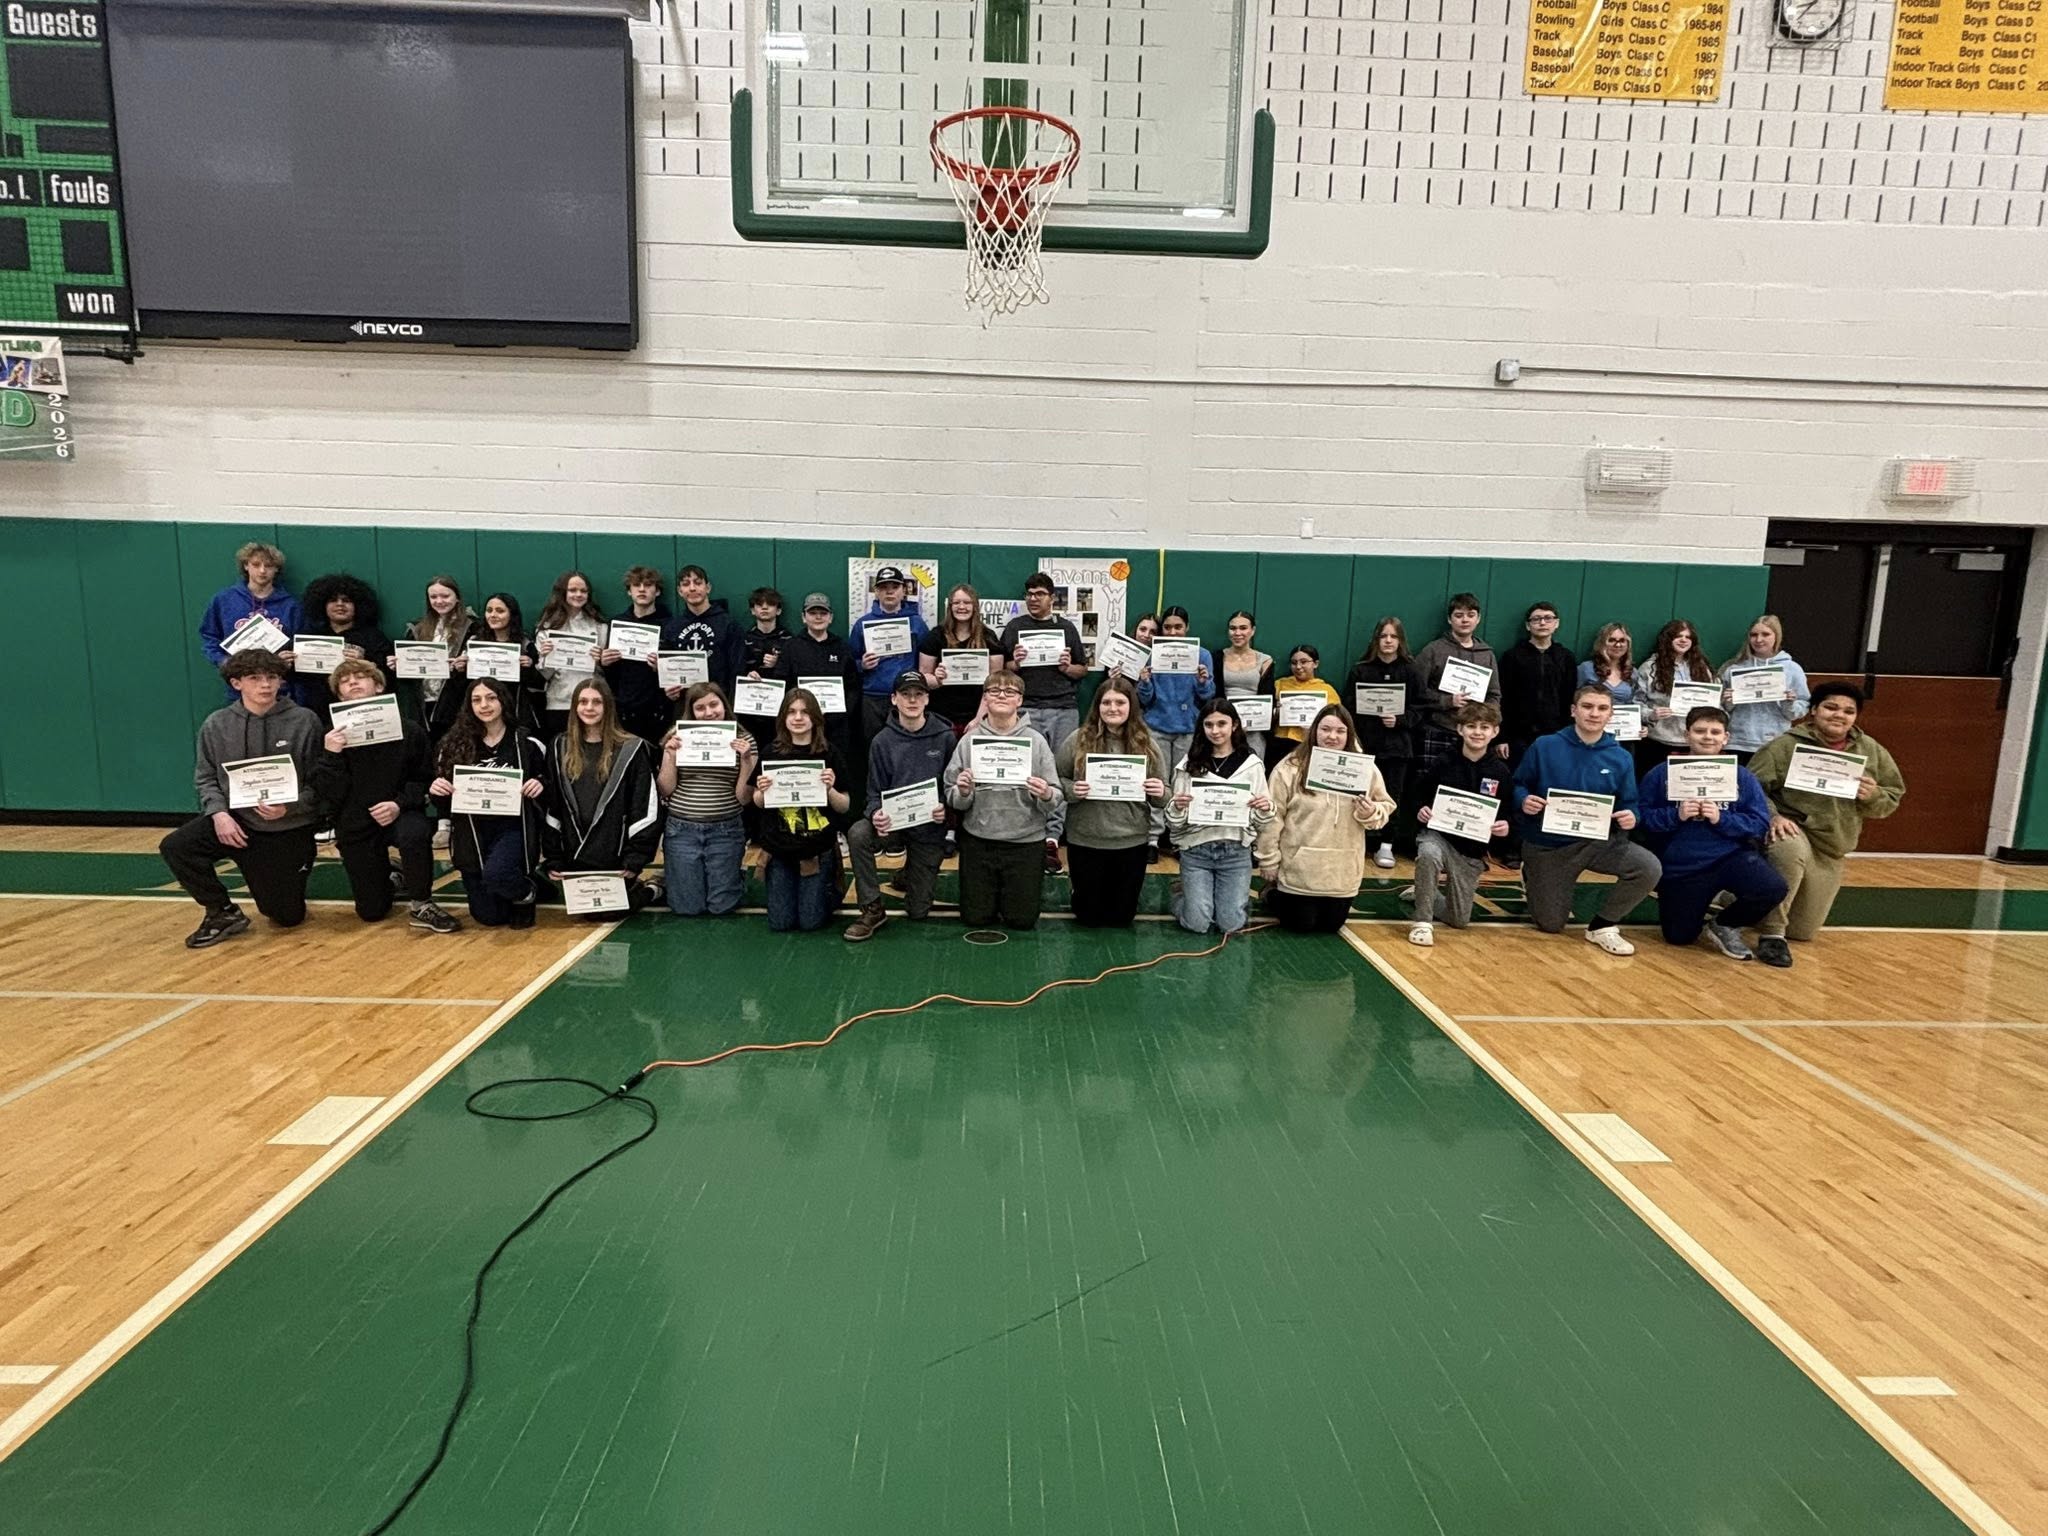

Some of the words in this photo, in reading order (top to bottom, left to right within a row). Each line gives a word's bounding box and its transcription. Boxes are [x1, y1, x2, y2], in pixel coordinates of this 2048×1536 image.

[1602, 0, 1628, 12] Boys
[1632, 1, 1660, 13] Class
[1661, 2, 1671, 13] C
[1702, 3, 1723, 15] 1984
[1965, 0, 1990, 12] Boys
[1998, 0, 2025, 11] Class
[2028, 2, 2041, 12] C2
[7, 3, 98, 38] Guests
[1535, 12, 1575, 28] Bowling
[1600, 15, 1625, 27] Girls
[1630, 16, 1657, 29] Class
[1659, 18, 1669, 29] C
[1684, 19, 1722, 31] 1985-86
[1898, 12, 1939, 24] Football
[1963, 14, 1989, 28] Boys
[1995, 15, 2023, 27] Class
[2026, 16, 2034, 27] D
[1534, 29, 1560, 41] Track
[1598, 32, 1624, 45] Boys
[1629, 33, 1656, 45] Class
[1658, 34, 1667, 45] C
[1897, 28, 1923, 40] Track
[1961, 30, 1986, 44] Boys
[1993, 31, 2021, 43] Class
[2023, 32, 2037, 43] C1
[1532, 45, 1575, 59] Baseball
[1596, 48, 1622, 60] Boys
[1627, 48, 1654, 60] Class
[1656, 51, 1665, 62] C
[1695, 52, 1718, 63] 1987
[1895, 44, 1921, 56] Track
[1959, 47, 1984, 59] Boys
[1991, 47, 2019, 59] Class
[2021, 48, 2035, 59] C1
[1531, 61, 1575, 74] Baseball
[1595, 64, 1620, 76] Boys
[1625, 65, 1651, 77] Class
[1655, 66, 1668, 77] C1
[1893, 60, 1926, 72] Indoor
[1928, 61, 1954, 73] Track
[1957, 62, 1981, 74] Girls
[1989, 63, 2016, 75] Class
[2019, 64, 2028, 75] C
[1530, 78, 1557, 90] Track
[1593, 80, 1619, 93] Boys
[1623, 80, 1650, 93] Class
[1653, 82, 1661, 92] D
[1691, 85, 1713, 95] 1991
[1891, 77, 1923, 88] Indoor
[1926, 77, 1952, 89] Track
[1955, 78, 1980, 92] Boys
[1987, 79, 2015, 91] Class
[2018, 80, 2026, 91] C
[51, 173, 110, 204] fouls
[67, 292, 116, 314] won
[363, 322, 423, 336] NEVCO
[48, 393, 69, 457] 2026
[980, 600, 1019, 615] VONNA
[980, 613, 1004, 625] HITE
[678, 622, 715, 640] NEWPORT
[347, 706, 383, 716] ATTENDANCE
[364, 730, 375, 740] H
[702, 752, 711, 761] H
[242, 765, 279, 775] ATTENDANCE
[996, 768, 1005, 778] H
[469, 776, 507, 784] ATTENDANCE
[1815, 778, 1828, 789] H
[258, 789, 269, 800] H
[791, 792, 800, 802] H
[1111, 786, 1121, 796] H
[1204, 788, 1237, 796] ATTENDANCE
[1697, 786, 1707, 797] H
[481, 799, 491, 810] H
[1449, 798, 1484, 810] ATTENDANCE
[1561, 799, 1598, 808] ATTENDANCE
[1214, 811, 1224, 821] H
[1454, 821, 1465, 831] H
[1570, 821, 1581, 831] H
[592, 897, 603, 907] H
